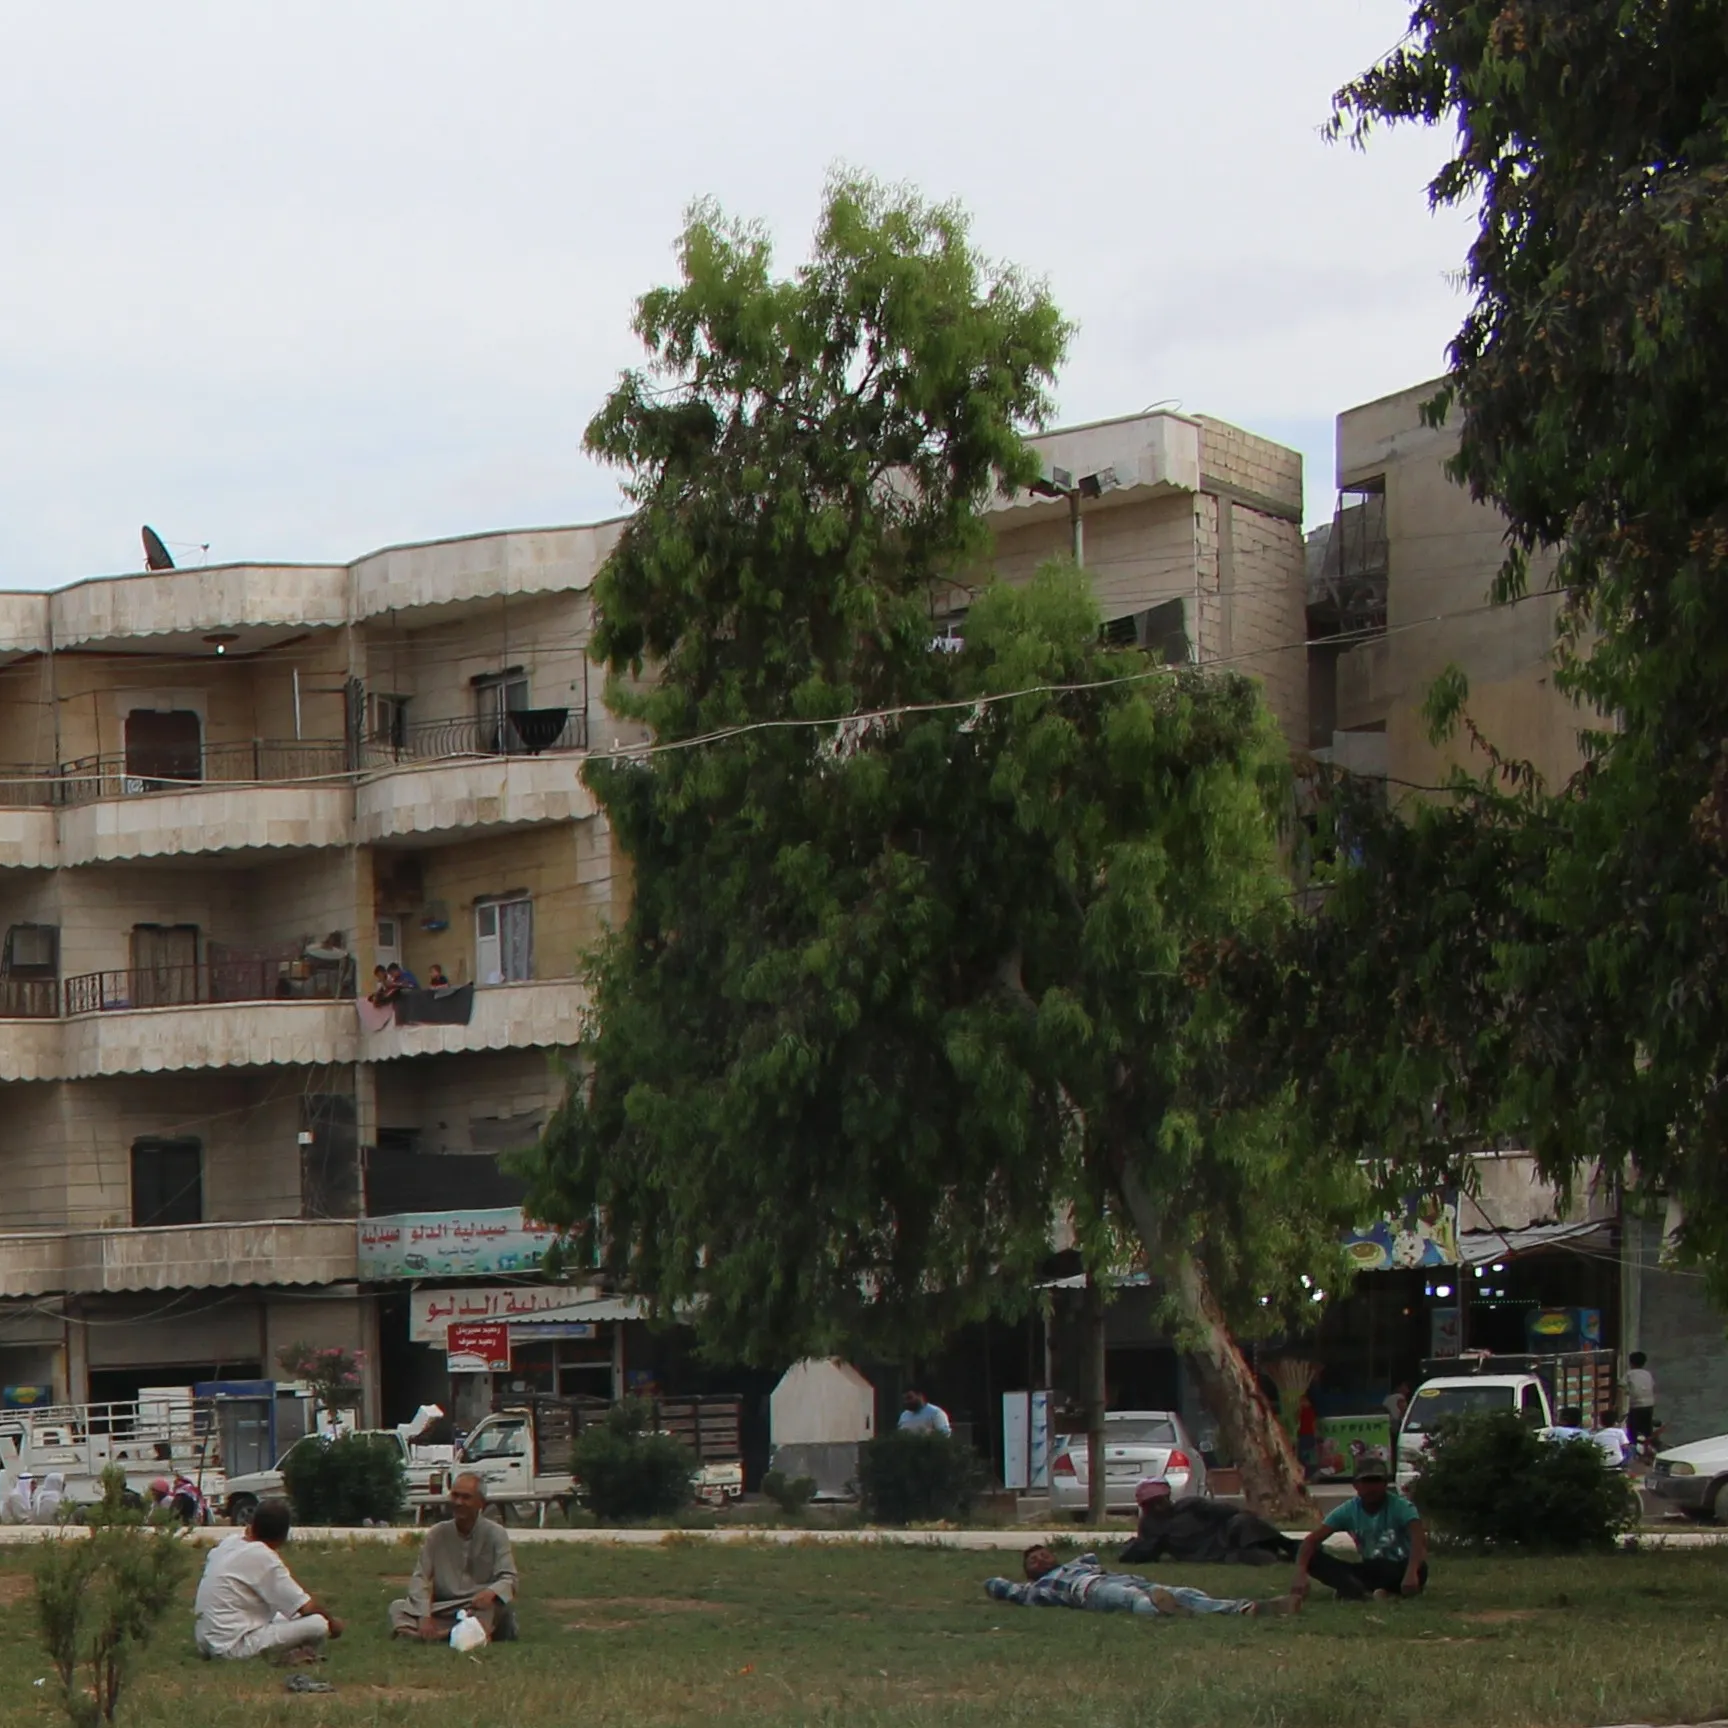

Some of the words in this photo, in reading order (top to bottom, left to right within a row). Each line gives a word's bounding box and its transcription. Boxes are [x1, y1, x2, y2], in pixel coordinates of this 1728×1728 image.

[410, 1224, 448, 1245] الدلو
[454, 1220, 507, 1243] صيدلية
[425, 1295, 498, 1323] الدلو
